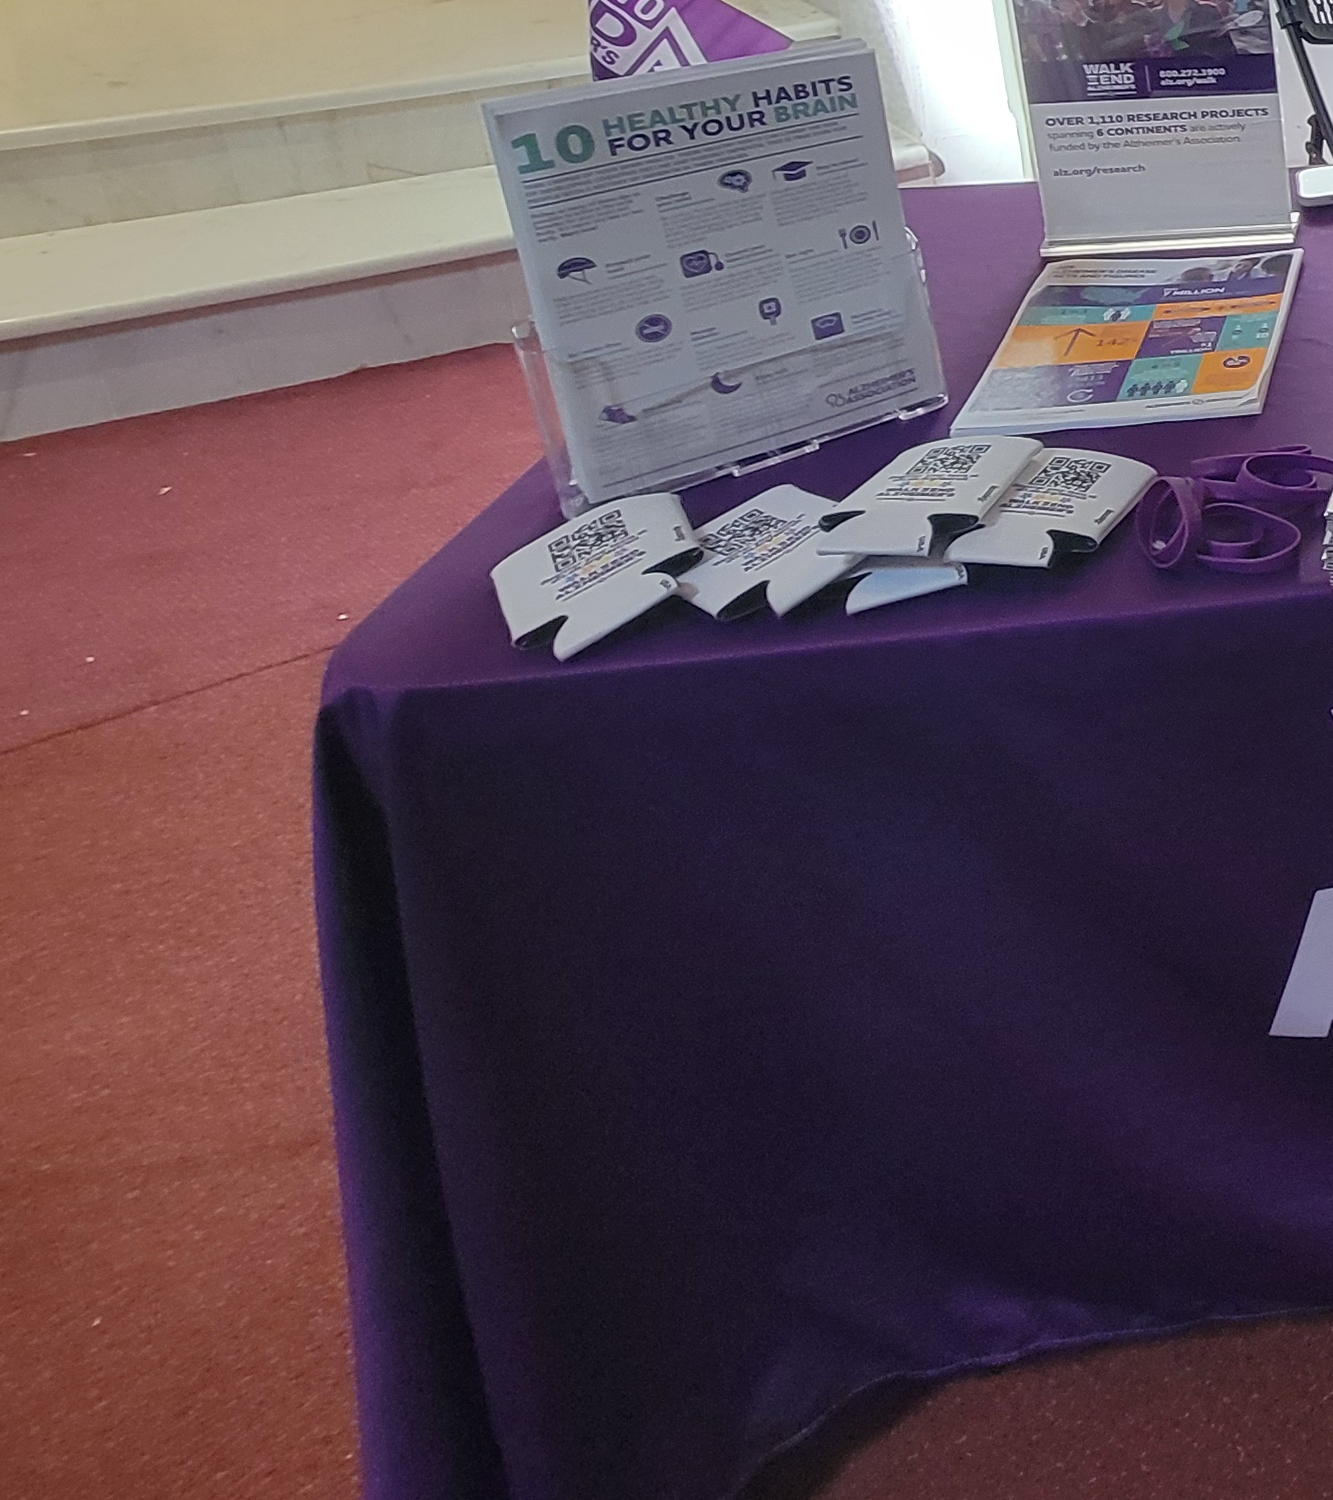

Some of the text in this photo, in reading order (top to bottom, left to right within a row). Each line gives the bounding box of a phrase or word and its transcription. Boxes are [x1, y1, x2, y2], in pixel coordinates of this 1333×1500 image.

[1083, 63, 1133, 74] WALK
[1100, 74, 1135, 85] END
[602, 75, 853, 137] HEALTHY HABITS
[607, 92, 858, 156] FOR YOUR BRAIN
[1045, 107, 1269, 127] OVER 1,110 RESEARCH PROJECTS
[1096, 127, 1104, 137] 6
[1106, 124, 1188, 136] CONTINENTS
[510, 123, 595, 175] 10
[1049, 143, 1086, 152] funded
[1088, 142, 1100, 152] by
[1102, 140, 1121, 149] the
[1122, 137, 1181, 148] Alzheimer's
[1053, 164, 1146, 178] alz.org/research
